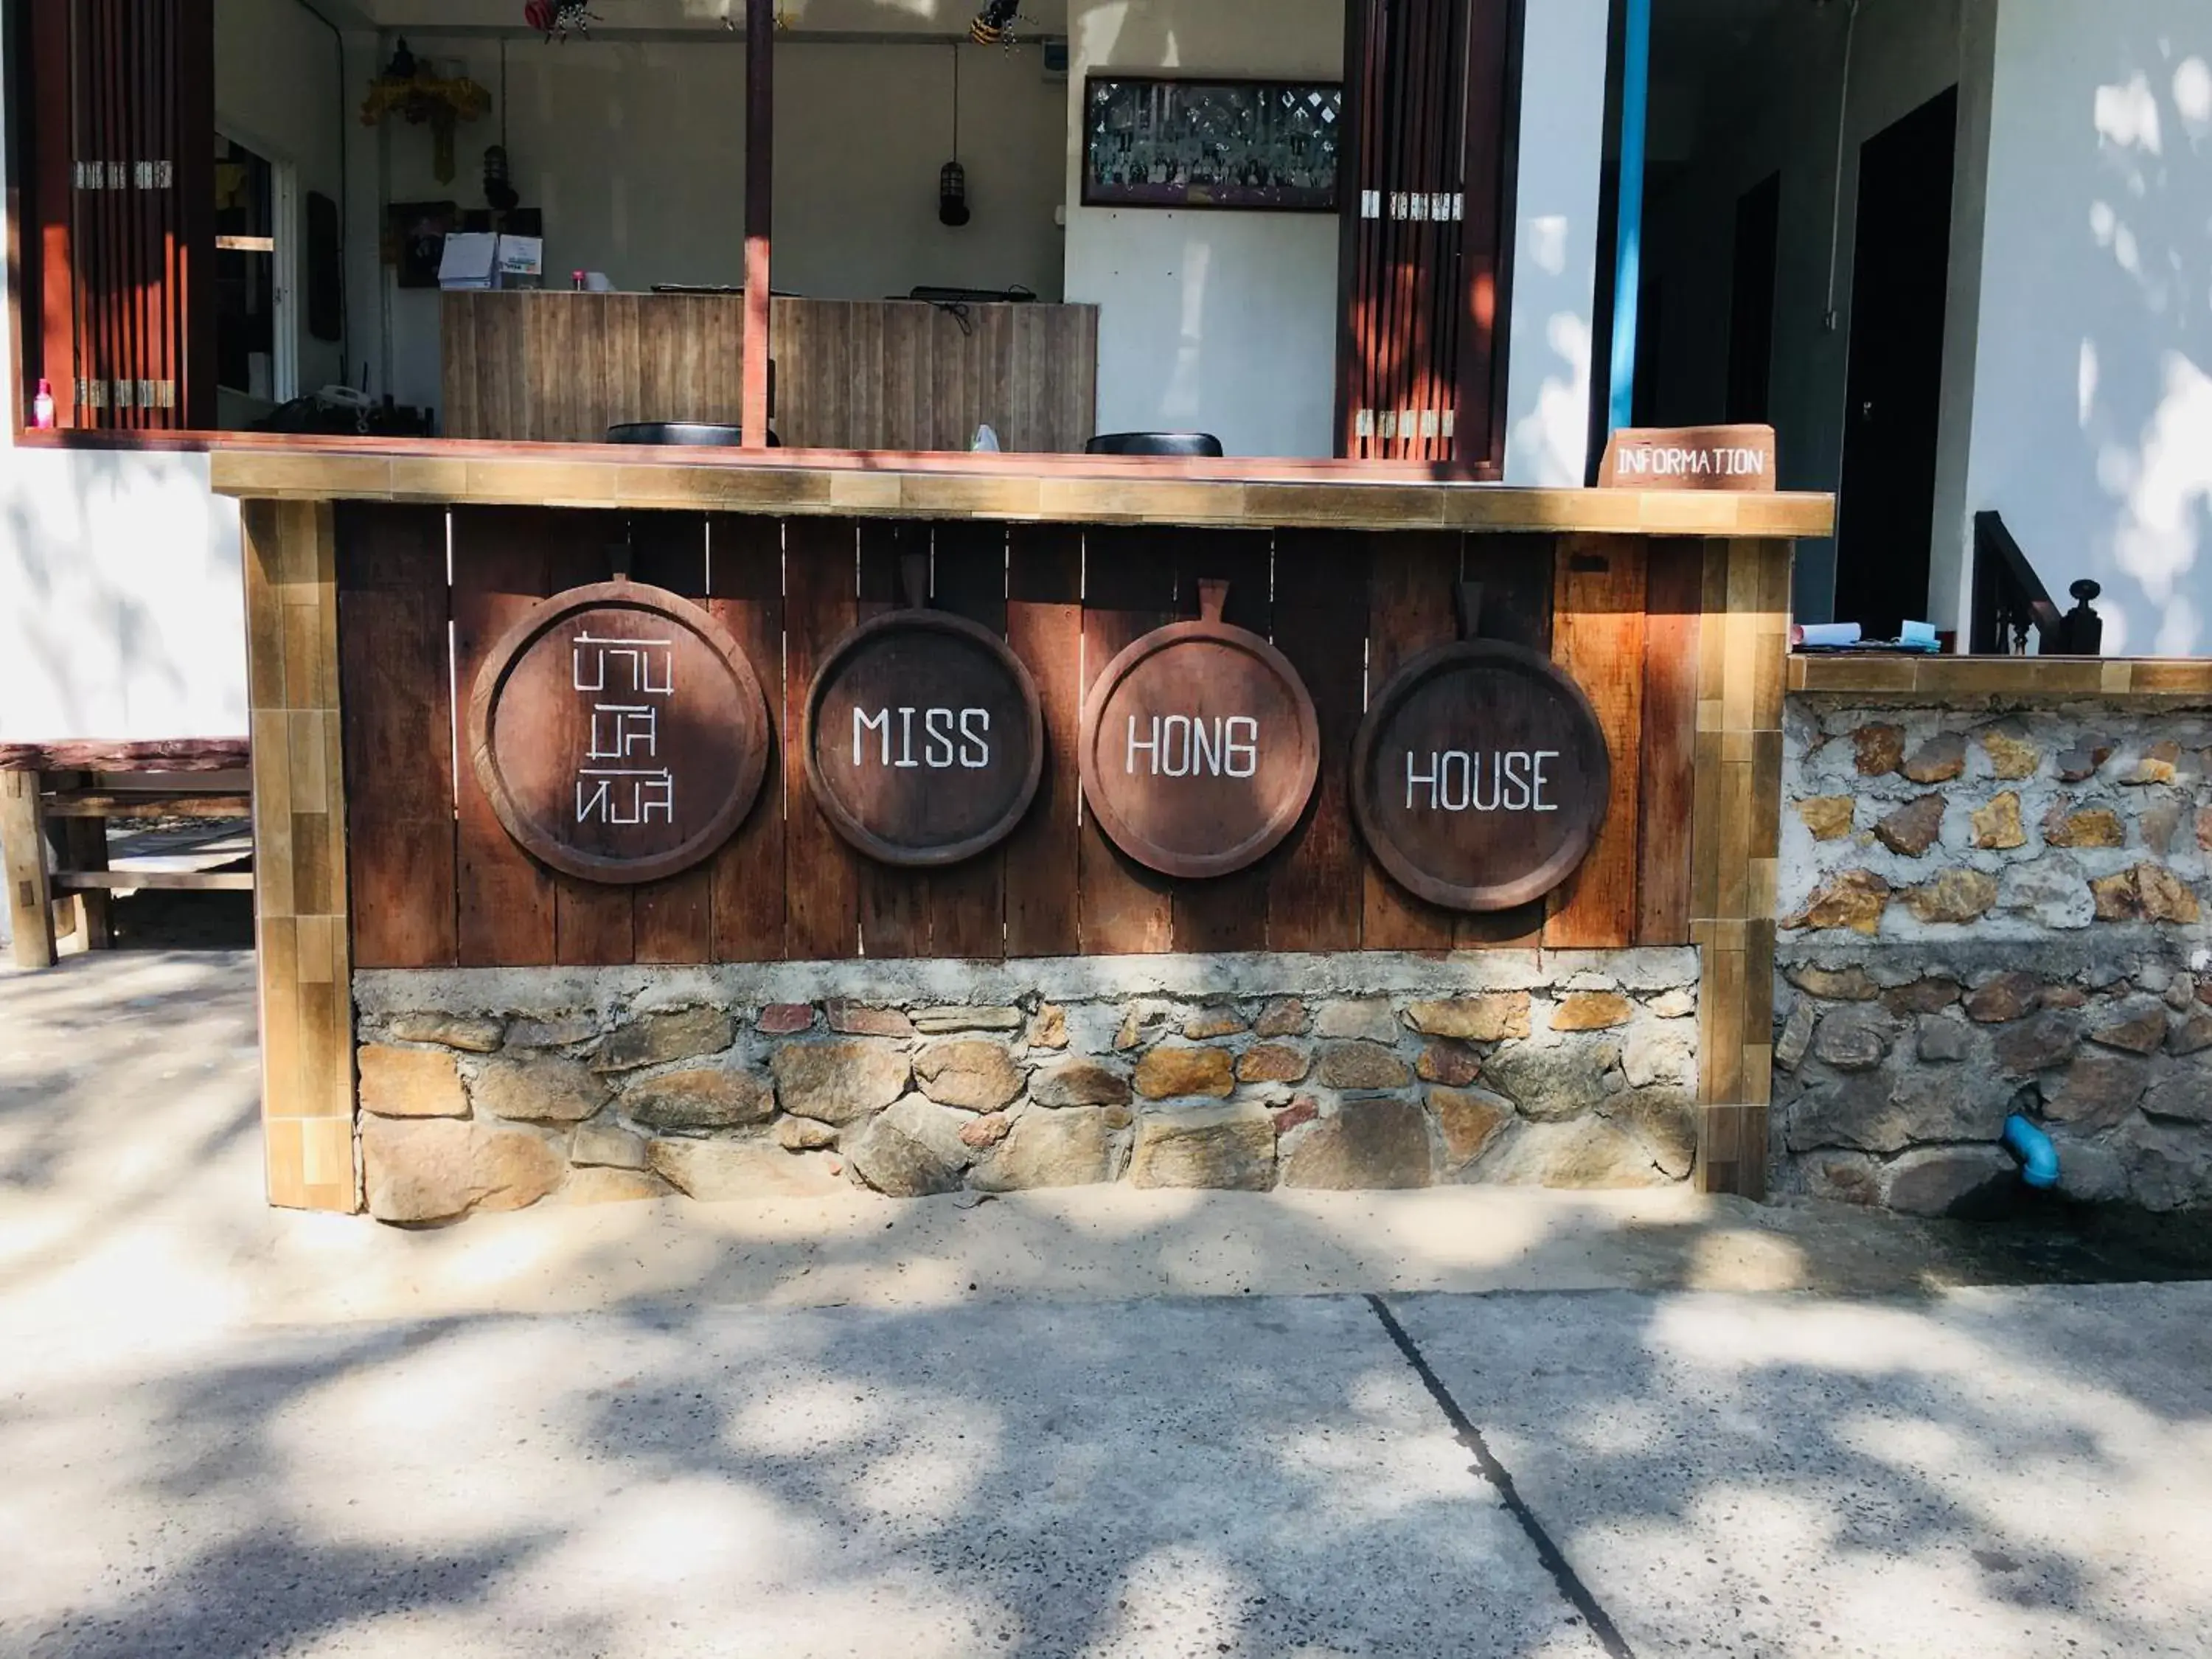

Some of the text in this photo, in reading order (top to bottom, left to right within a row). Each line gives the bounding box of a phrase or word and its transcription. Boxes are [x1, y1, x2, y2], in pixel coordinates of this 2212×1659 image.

[1617, 448, 1763, 474] INFORMATION
[853, 706, 1560, 811] MISS HONG HOUSE
